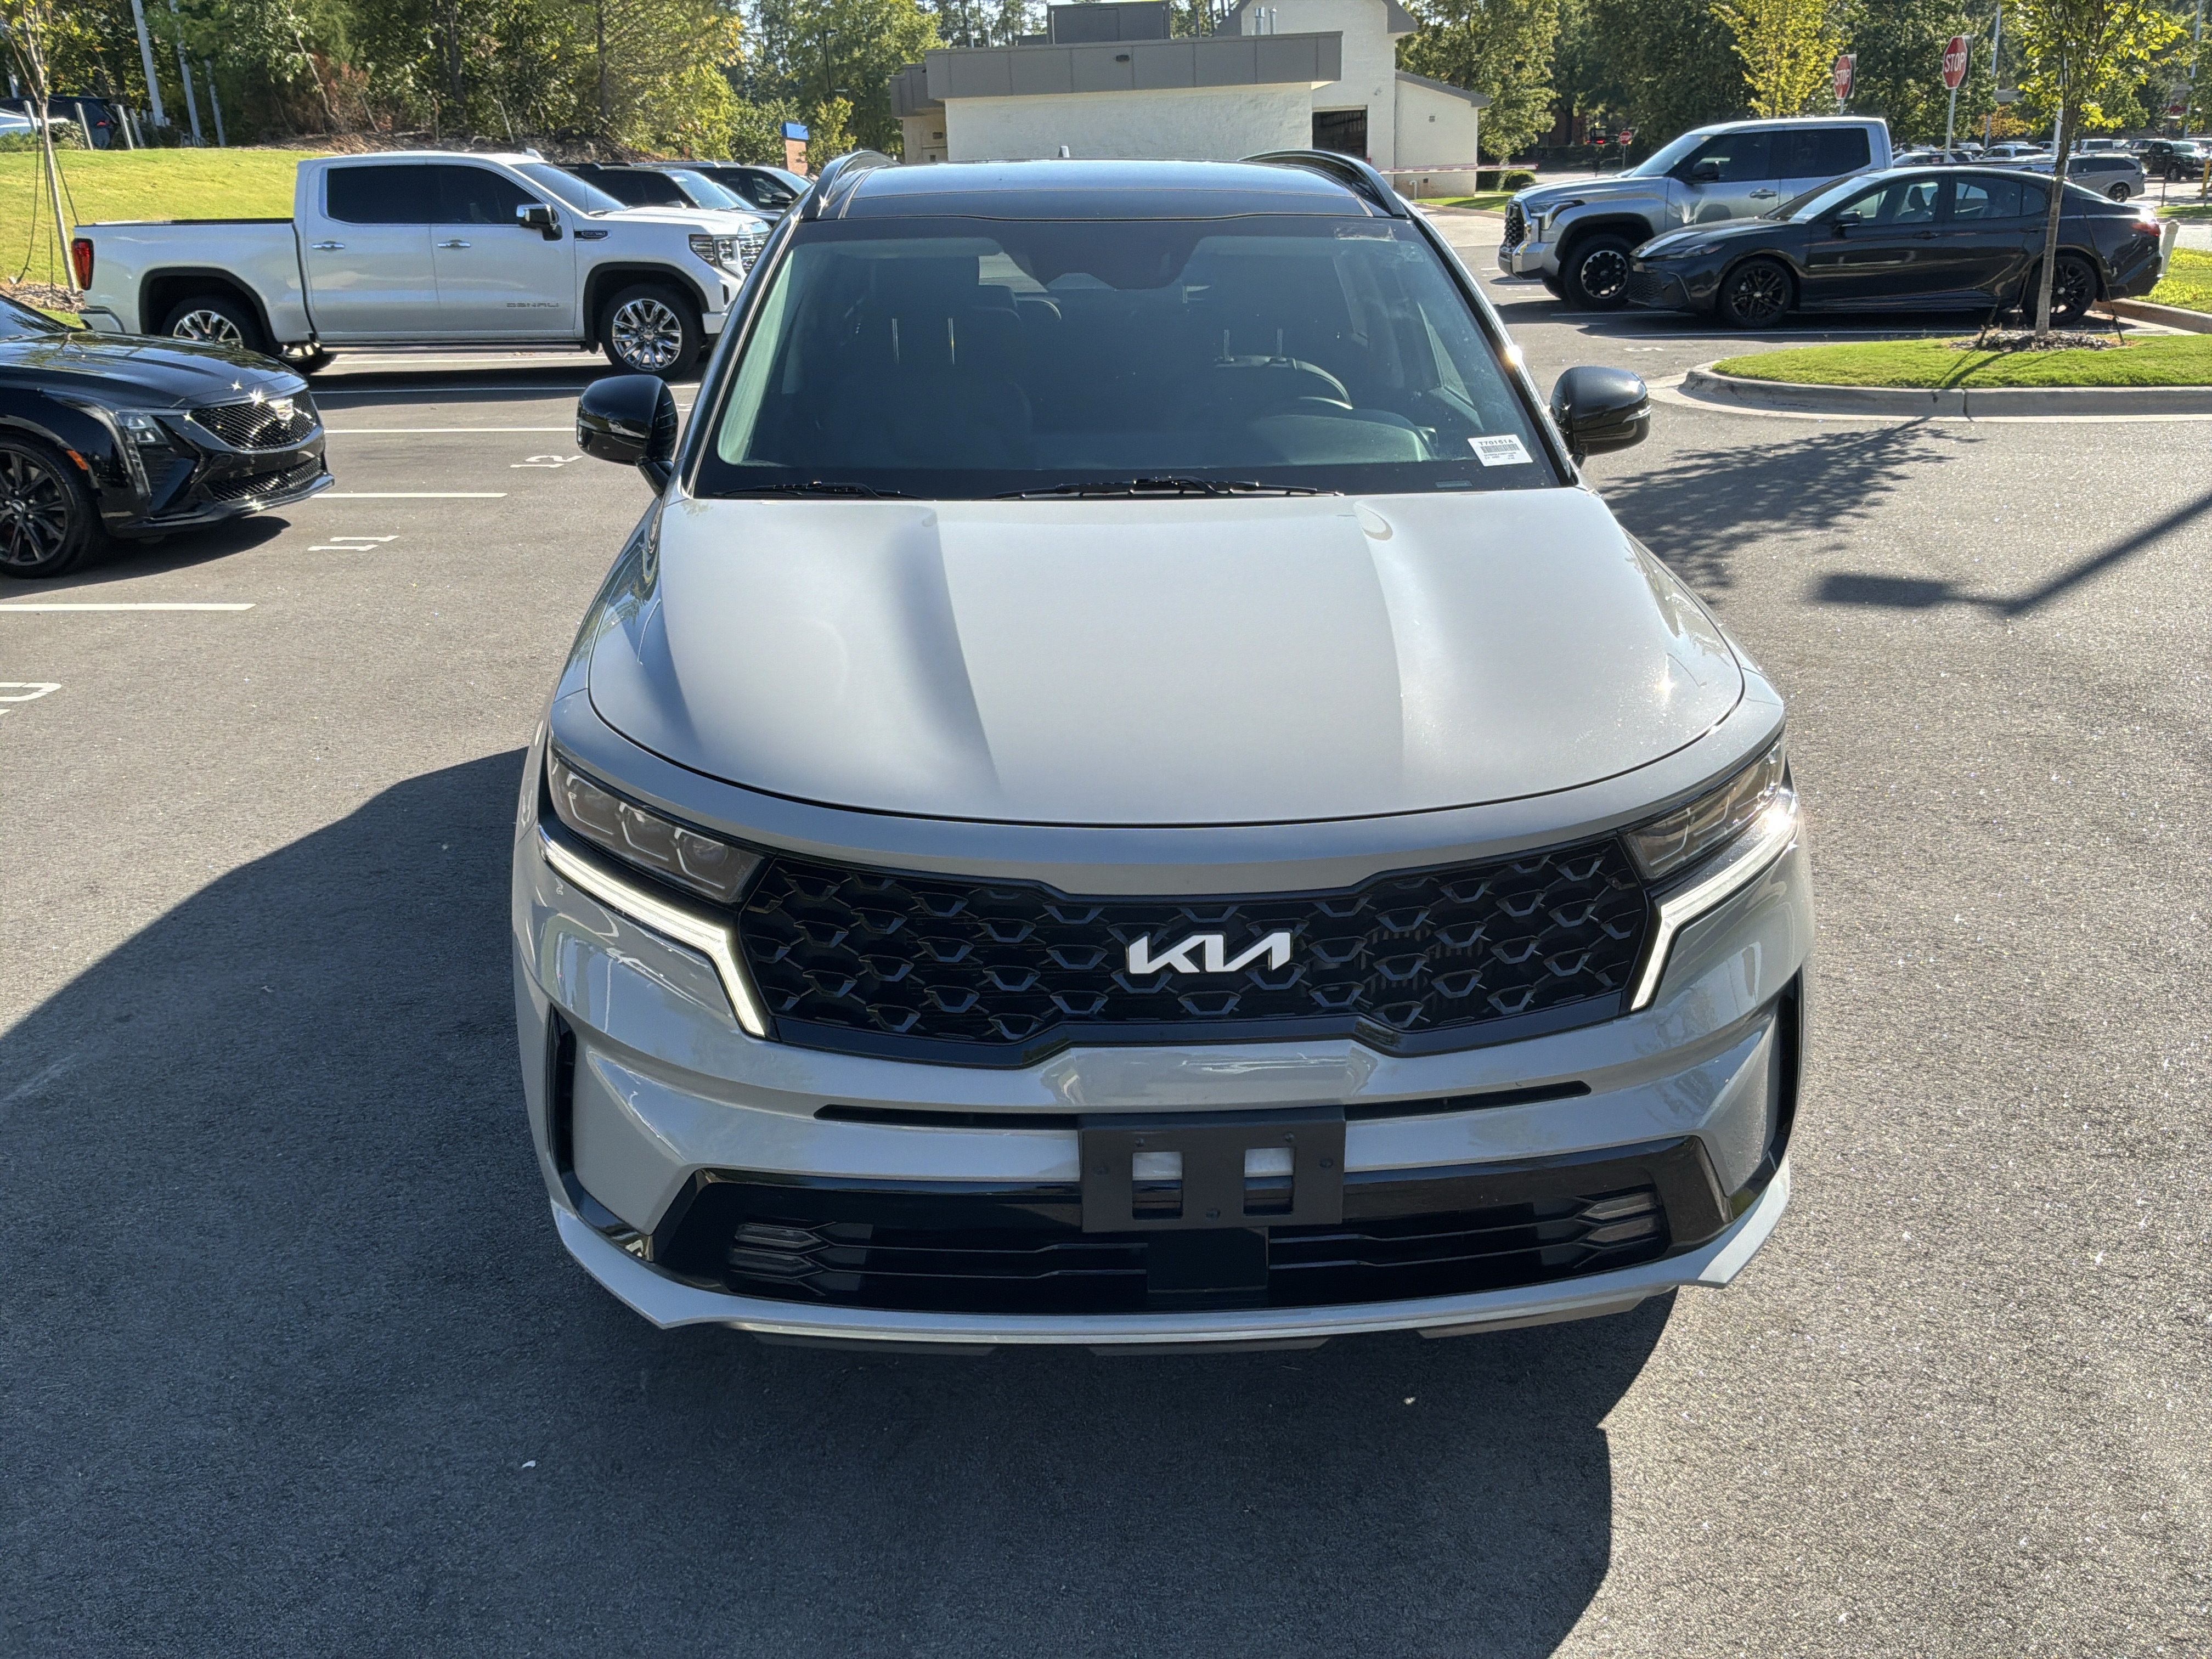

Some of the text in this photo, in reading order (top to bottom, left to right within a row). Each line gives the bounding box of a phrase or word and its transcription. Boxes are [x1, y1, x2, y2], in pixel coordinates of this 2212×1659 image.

[1944, 52, 1965, 73] STOP
[1835, 69, 1850, 86] STOP
[510, 455, 583, 467] 12
[307, 535, 399, 551] 11
[1128, 932, 1290, 974] KIA
